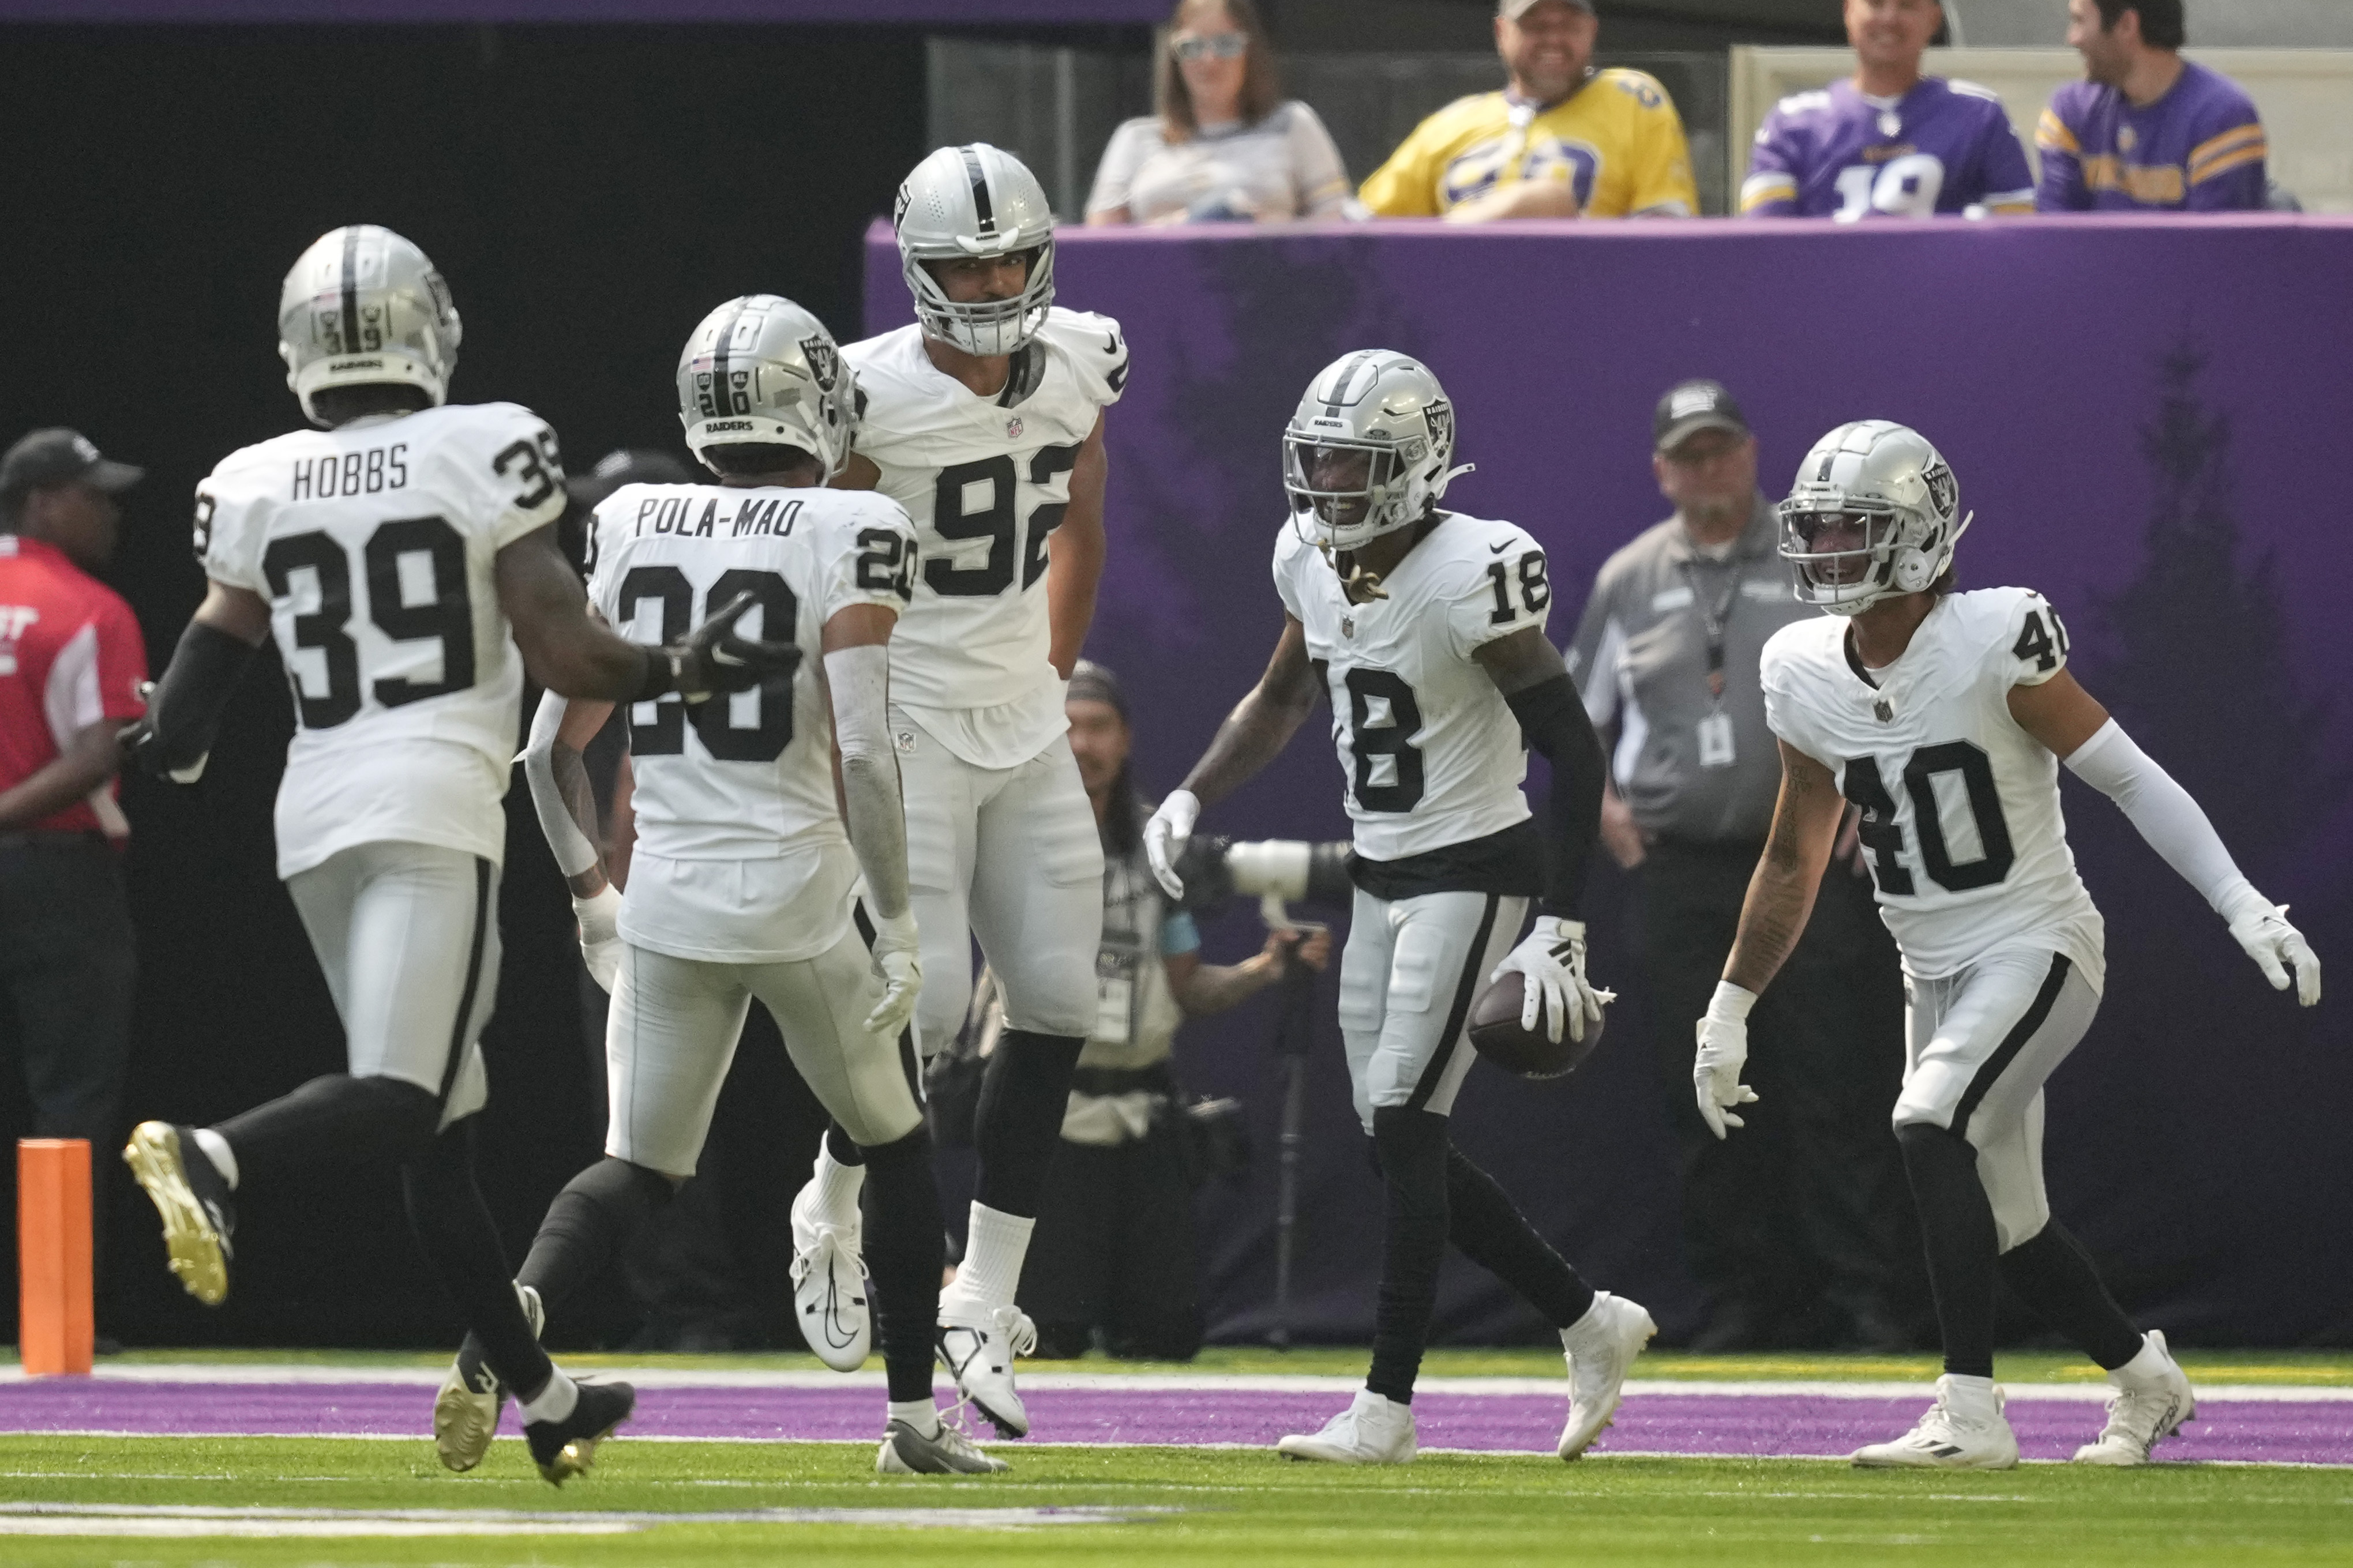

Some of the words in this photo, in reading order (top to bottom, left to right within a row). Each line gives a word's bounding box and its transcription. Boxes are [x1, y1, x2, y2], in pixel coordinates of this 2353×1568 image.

[1833, 153, 1944, 223] 19
[706, 420, 753, 433] RAIDERS
[293, 443, 407, 501] HOBBS
[636, 498, 804, 537] POLA-MAO
[924, 441, 1082, 596] 92
[857, 528, 918, 604] 20
[1487, 550, 1551, 624] 18
[262, 514, 475, 730] 39
[1844, 740, 2016, 896] 40
